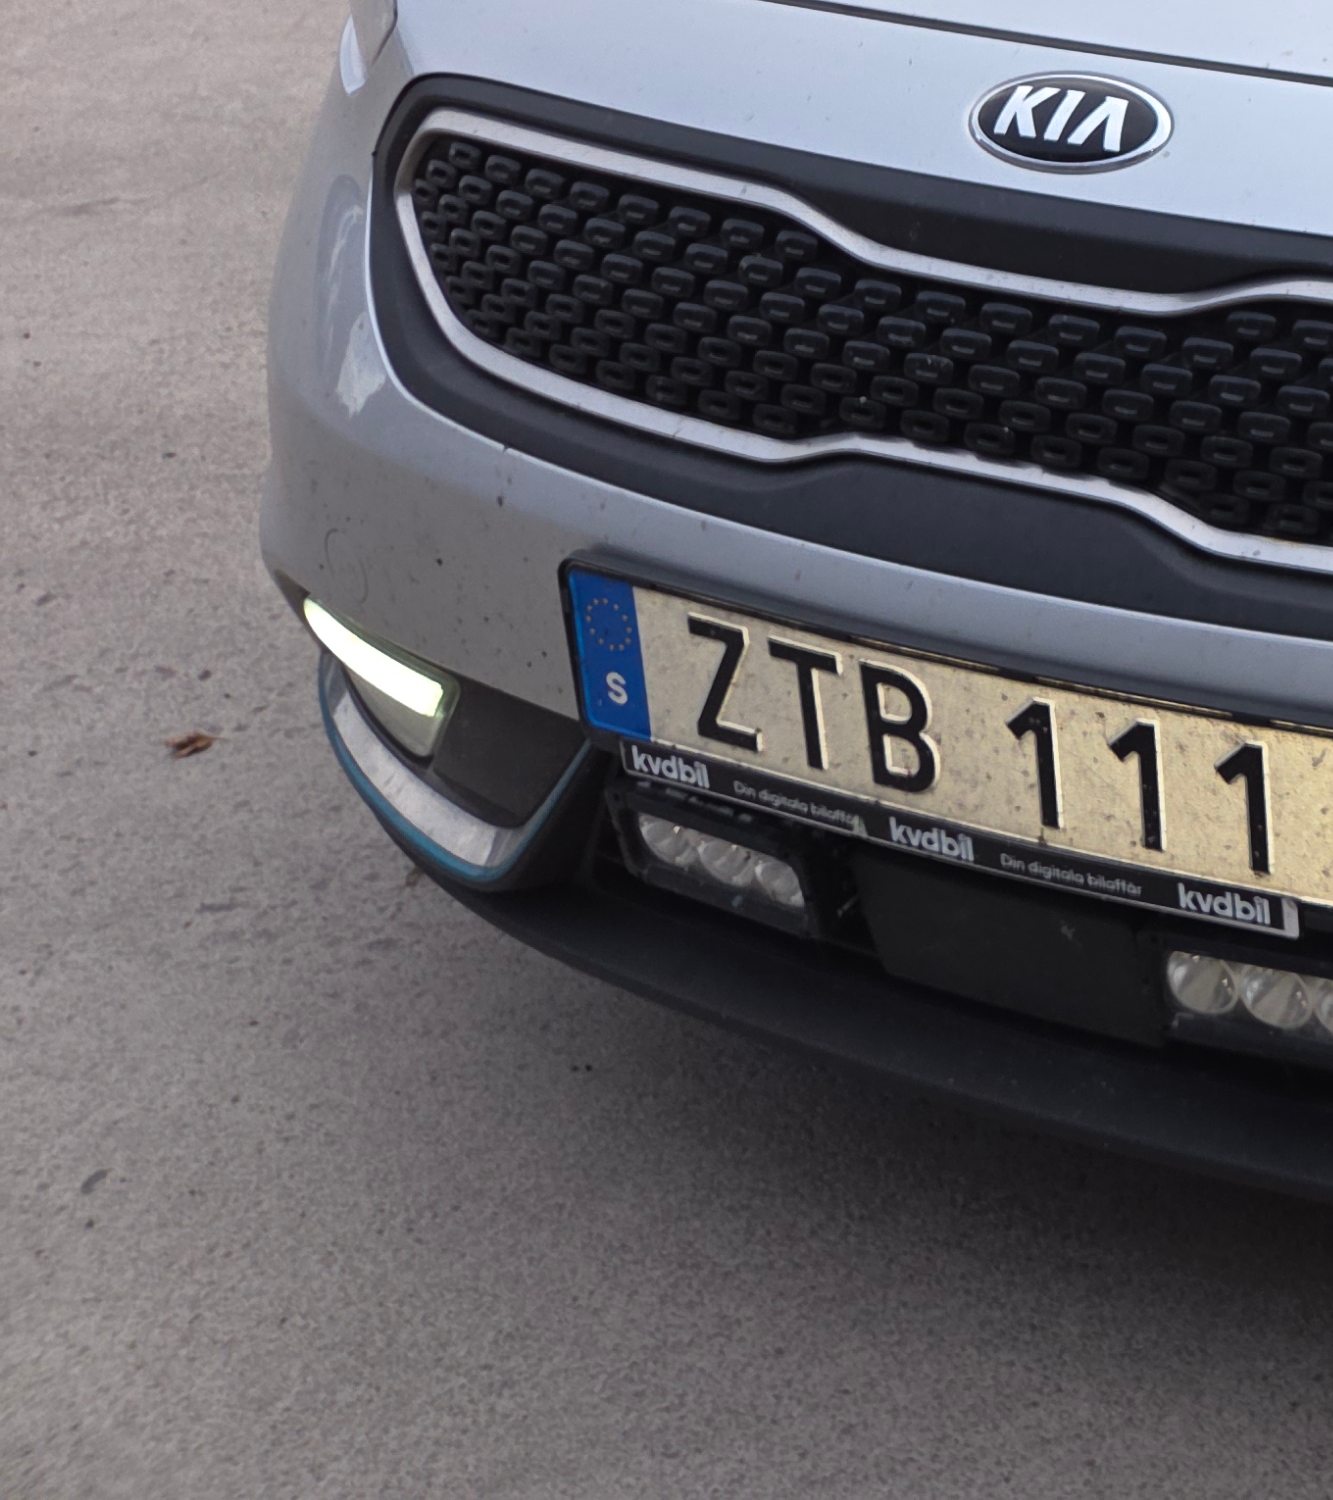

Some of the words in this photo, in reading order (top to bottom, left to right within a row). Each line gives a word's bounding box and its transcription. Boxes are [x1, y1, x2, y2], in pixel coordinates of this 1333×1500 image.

[993, 84, 1130, 153] KIA
[605, 671, 628, 706] S
[686, 611, 942, 794] ZTB
[1004, 695, 1271, 877] 111
[632, 744, 711, 790] kvdbil
[733, 779, 757, 800] Din
[888, 816, 975, 863] kvdbil
[1000, 852, 1026, 872] Din
[1028, 861, 1085, 885] digitala
[1177, 882, 1272, 926] kvdbil
